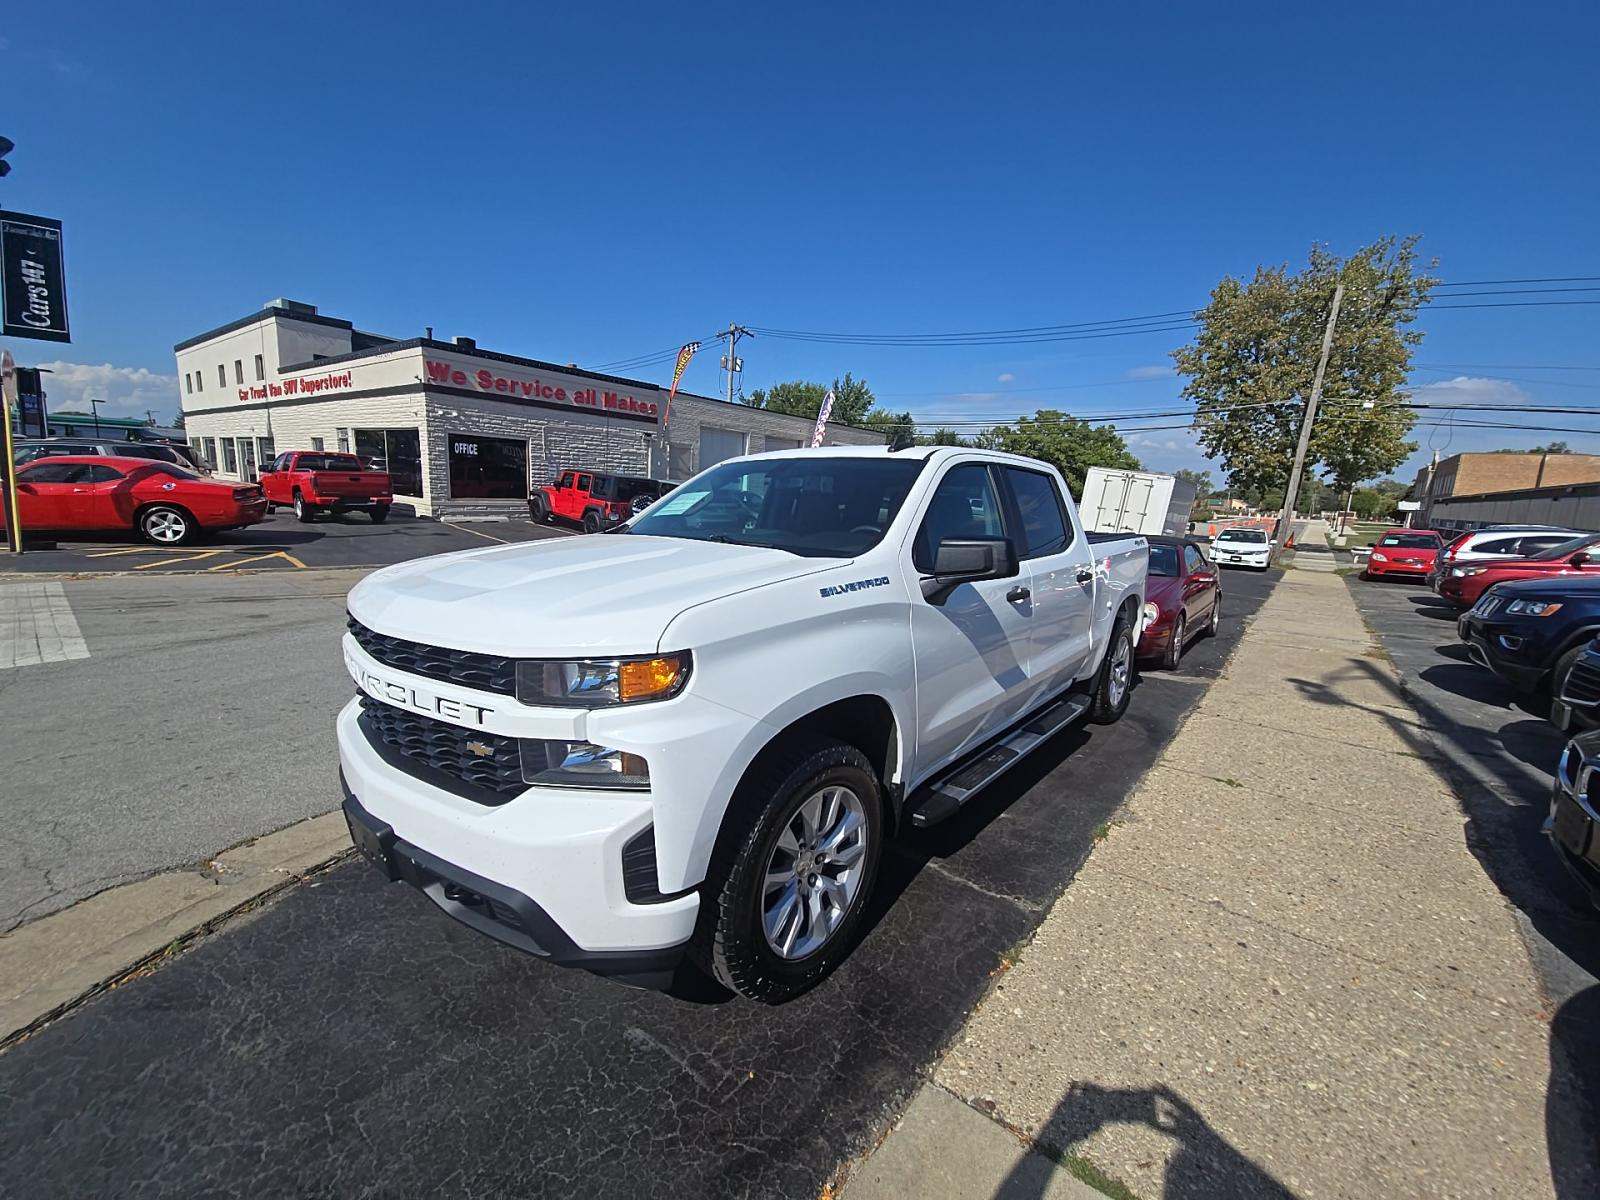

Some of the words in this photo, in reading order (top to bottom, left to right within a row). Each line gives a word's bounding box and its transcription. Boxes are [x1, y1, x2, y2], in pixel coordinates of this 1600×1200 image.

[238, 388, 249, 401] Car
[249, 385, 268, 399] Truck
[268, 383, 283, 398] Van
[283, 379, 298, 396] SUV
[300, 370, 353, 396] Superstore!
[426, 361, 467, 385] We
[476, 369, 566, 401] Service
[573, 388, 597, 406] all
[603, 391, 658, 415] Makes
[454, 442, 479, 455] OFFICE
[819, 576, 891, 598] SILVERADO
